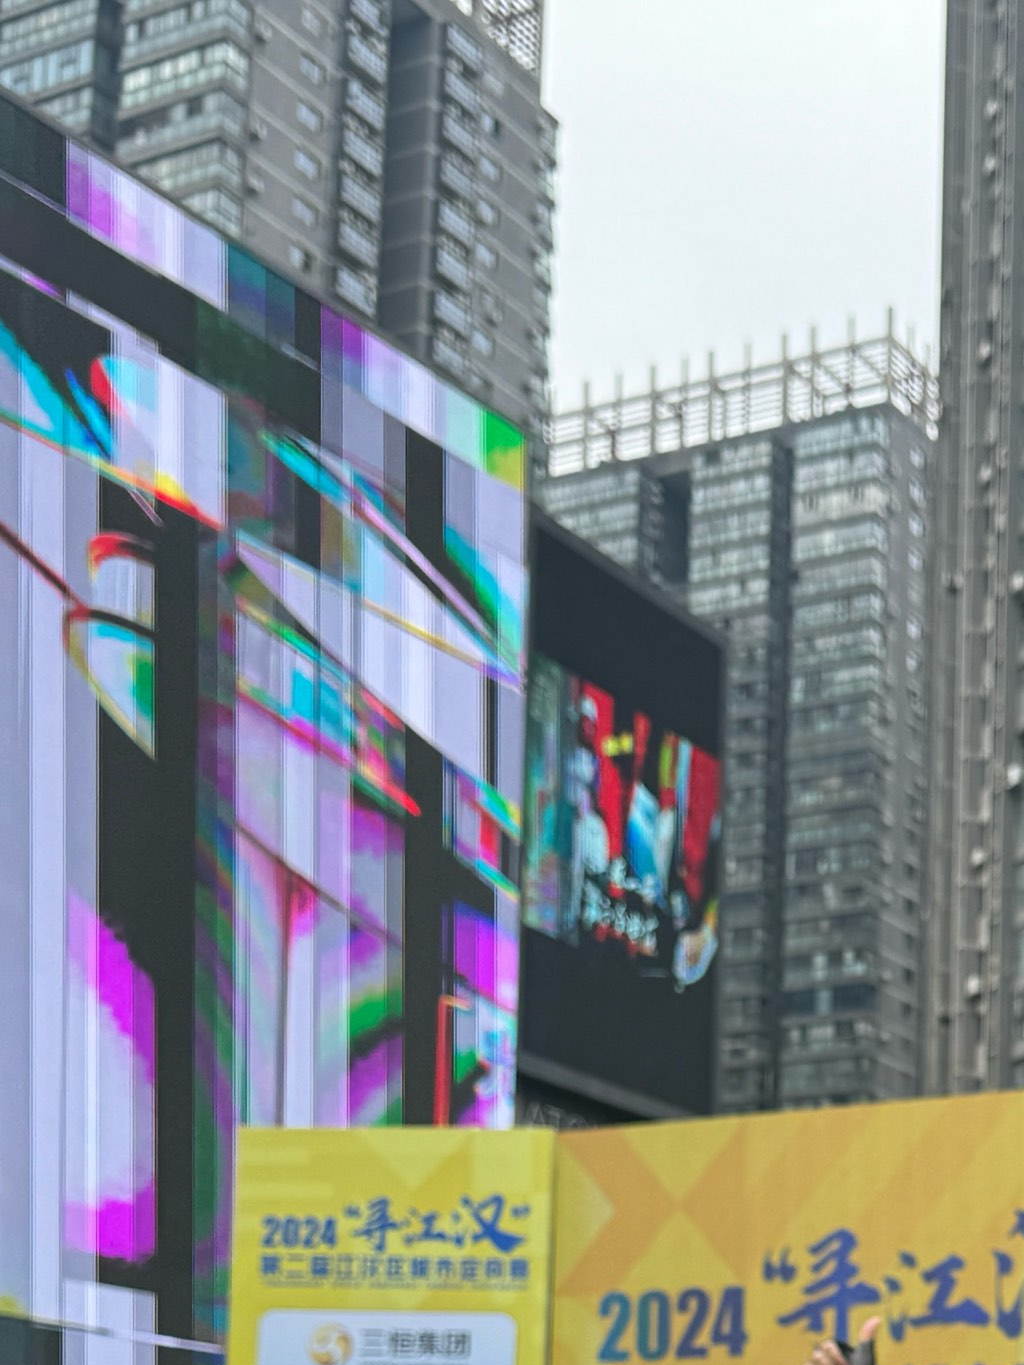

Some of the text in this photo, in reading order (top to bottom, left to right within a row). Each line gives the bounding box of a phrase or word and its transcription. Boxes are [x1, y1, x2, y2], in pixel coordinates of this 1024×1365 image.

[262, 1215, 338, 1248] 2024
[597, 1286, 748, 1362] 2024
[358, 1328, 472, 1359] 三恒集团
